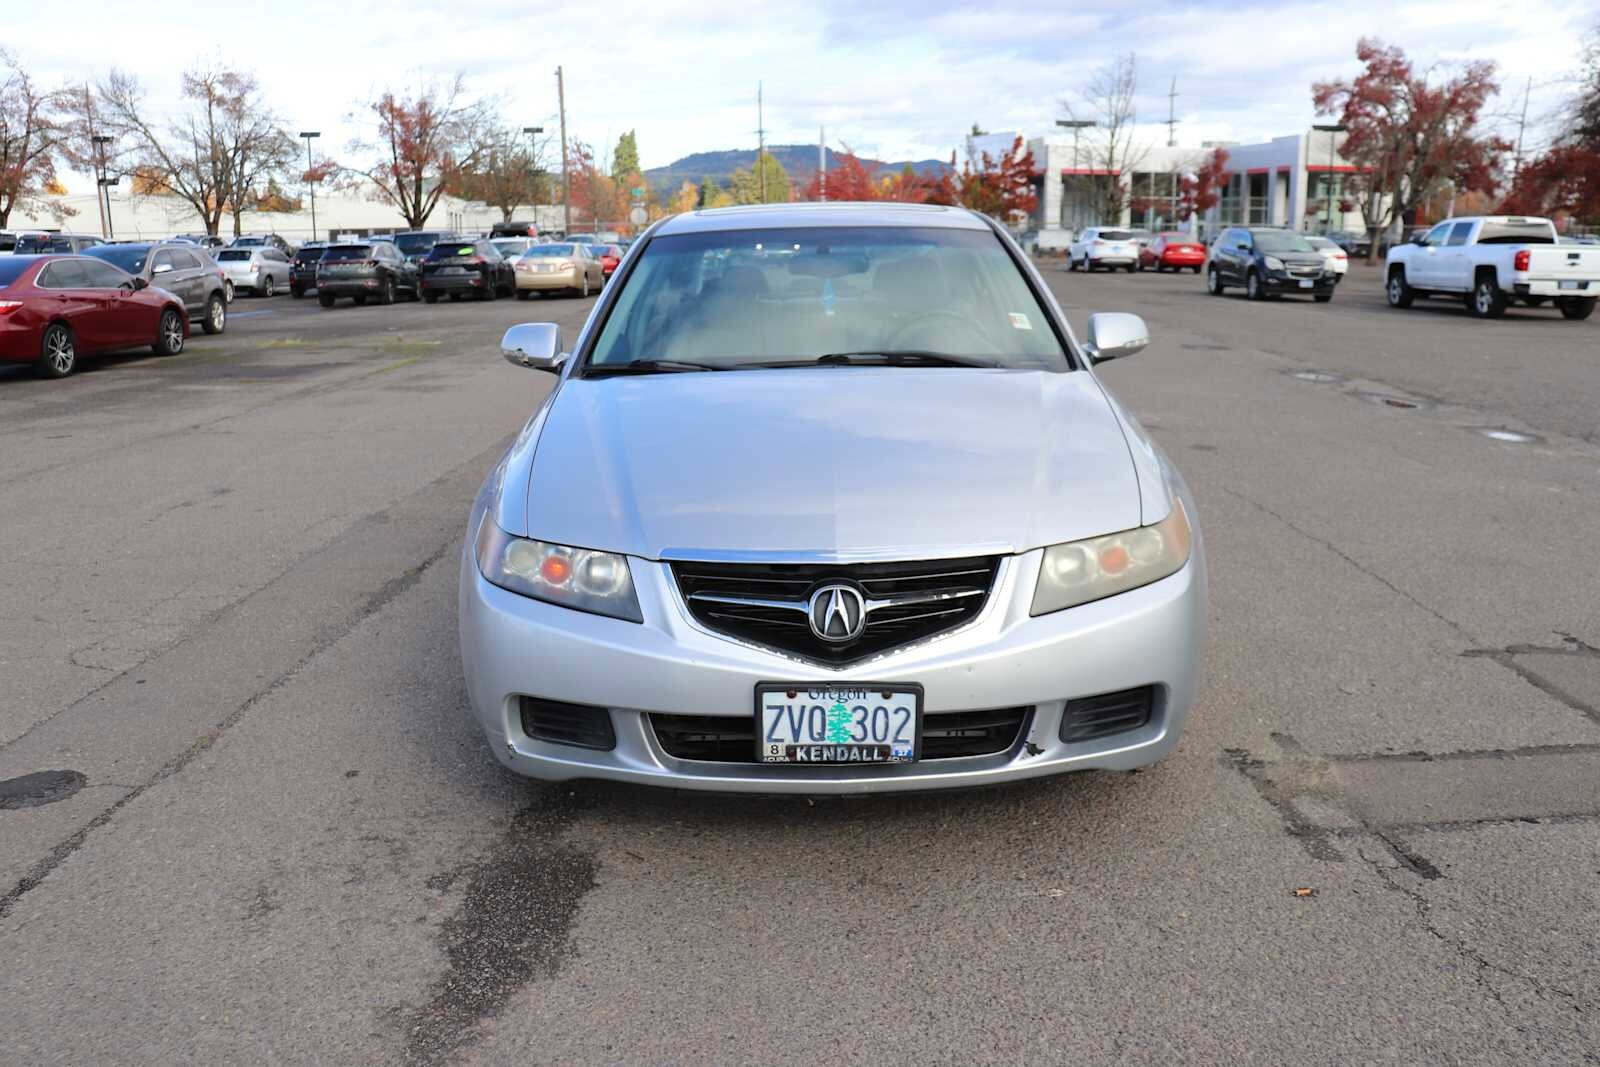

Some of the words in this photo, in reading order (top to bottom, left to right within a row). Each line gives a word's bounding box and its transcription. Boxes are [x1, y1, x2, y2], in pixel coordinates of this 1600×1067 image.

[808, 688, 867, 703] Oregon
[766, 705, 827, 743] ZVQ
[850, 705, 912, 744] 302
[770, 745, 779, 755] 8
[796, 746, 883, 761] KENDALL
